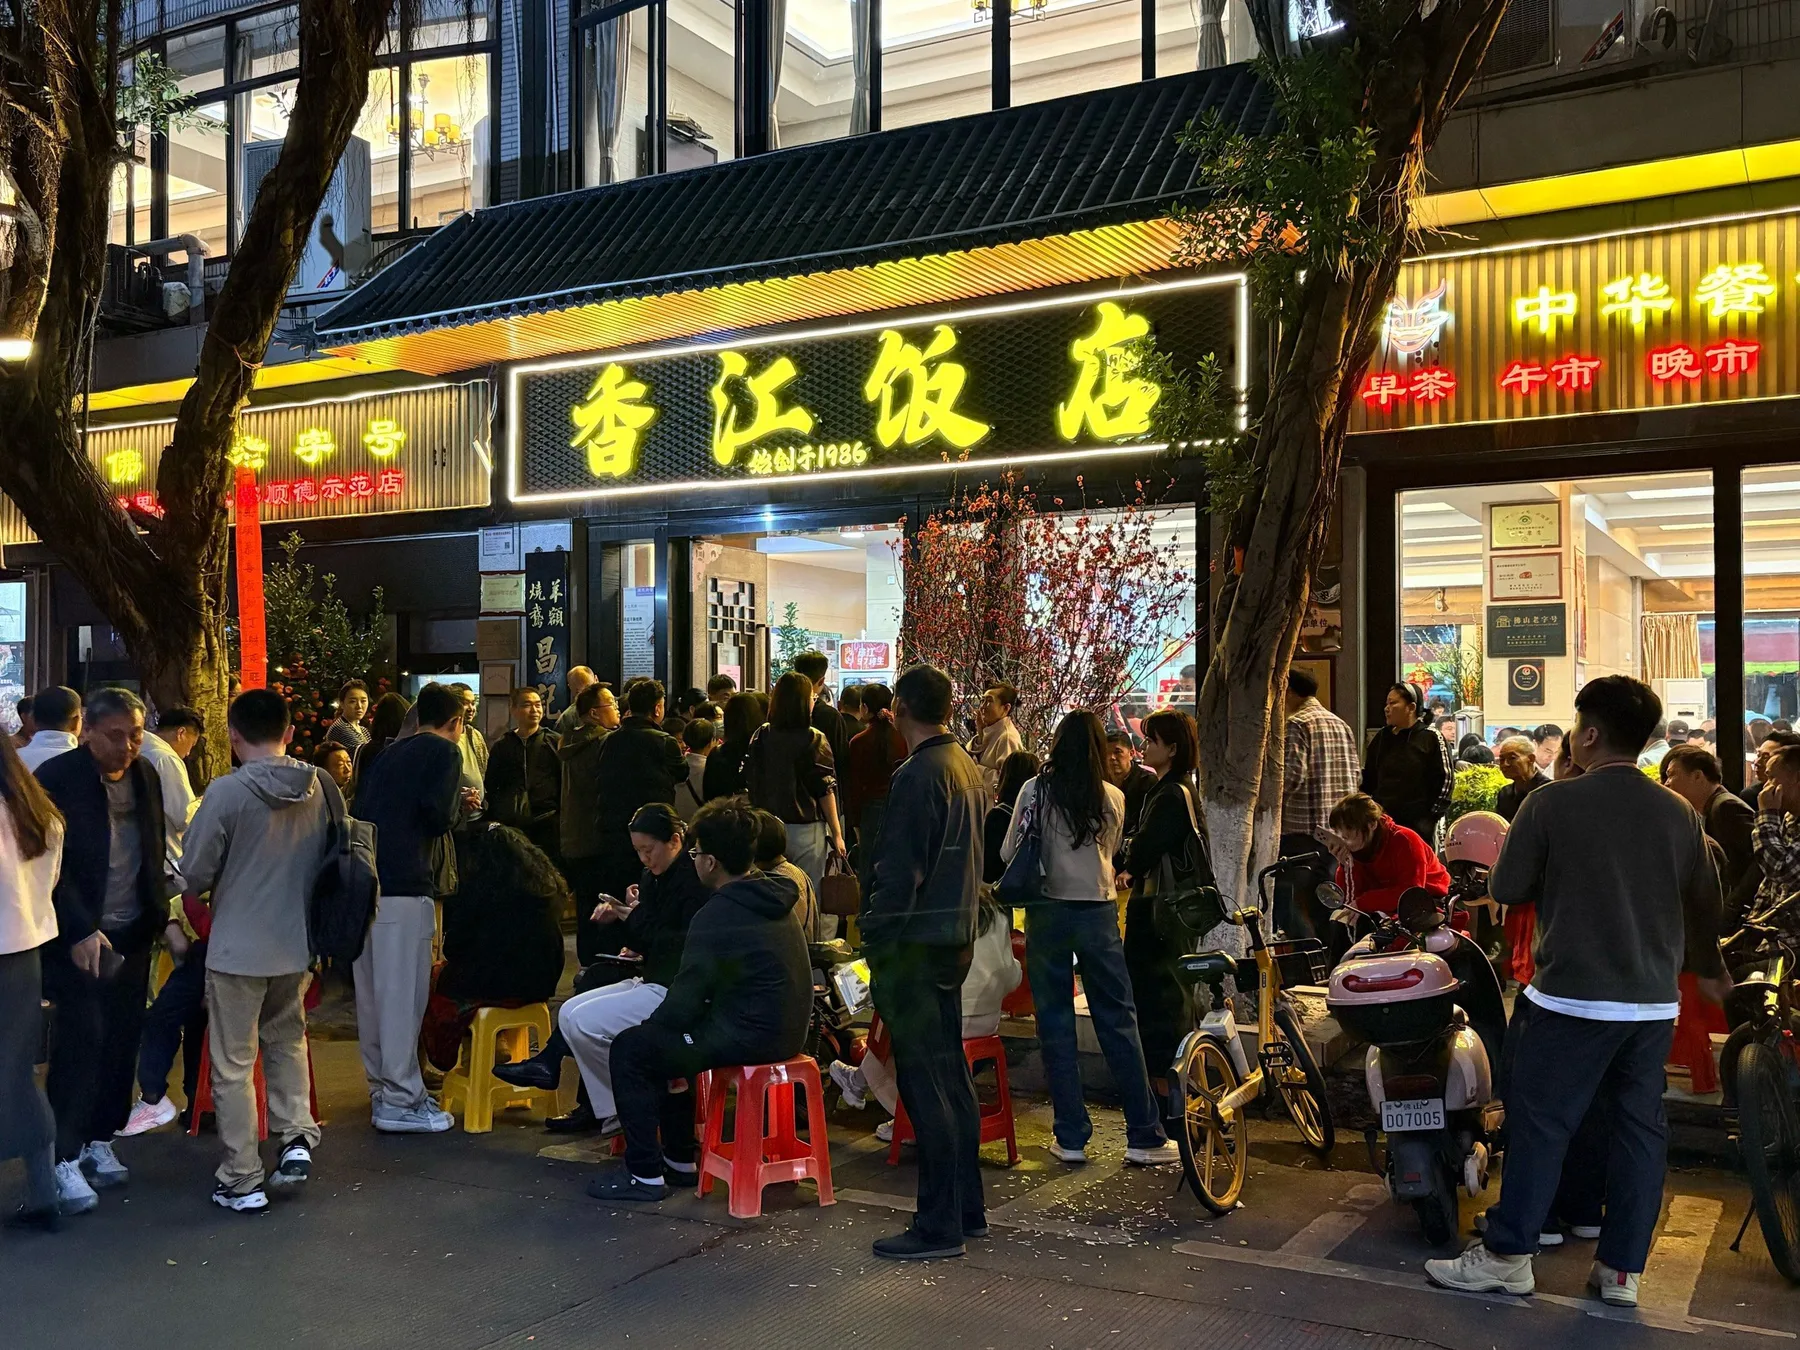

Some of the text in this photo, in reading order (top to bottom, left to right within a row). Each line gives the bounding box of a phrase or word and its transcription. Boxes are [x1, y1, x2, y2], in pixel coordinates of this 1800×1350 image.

[1513, 262, 1800, 334] 中华餐
[570, 302, 1162, 478] 香江饭店
[1362, 340, 1760, 405] 早茶 午市 晚市
[1386, 1111, 1441, 1129] D07005
